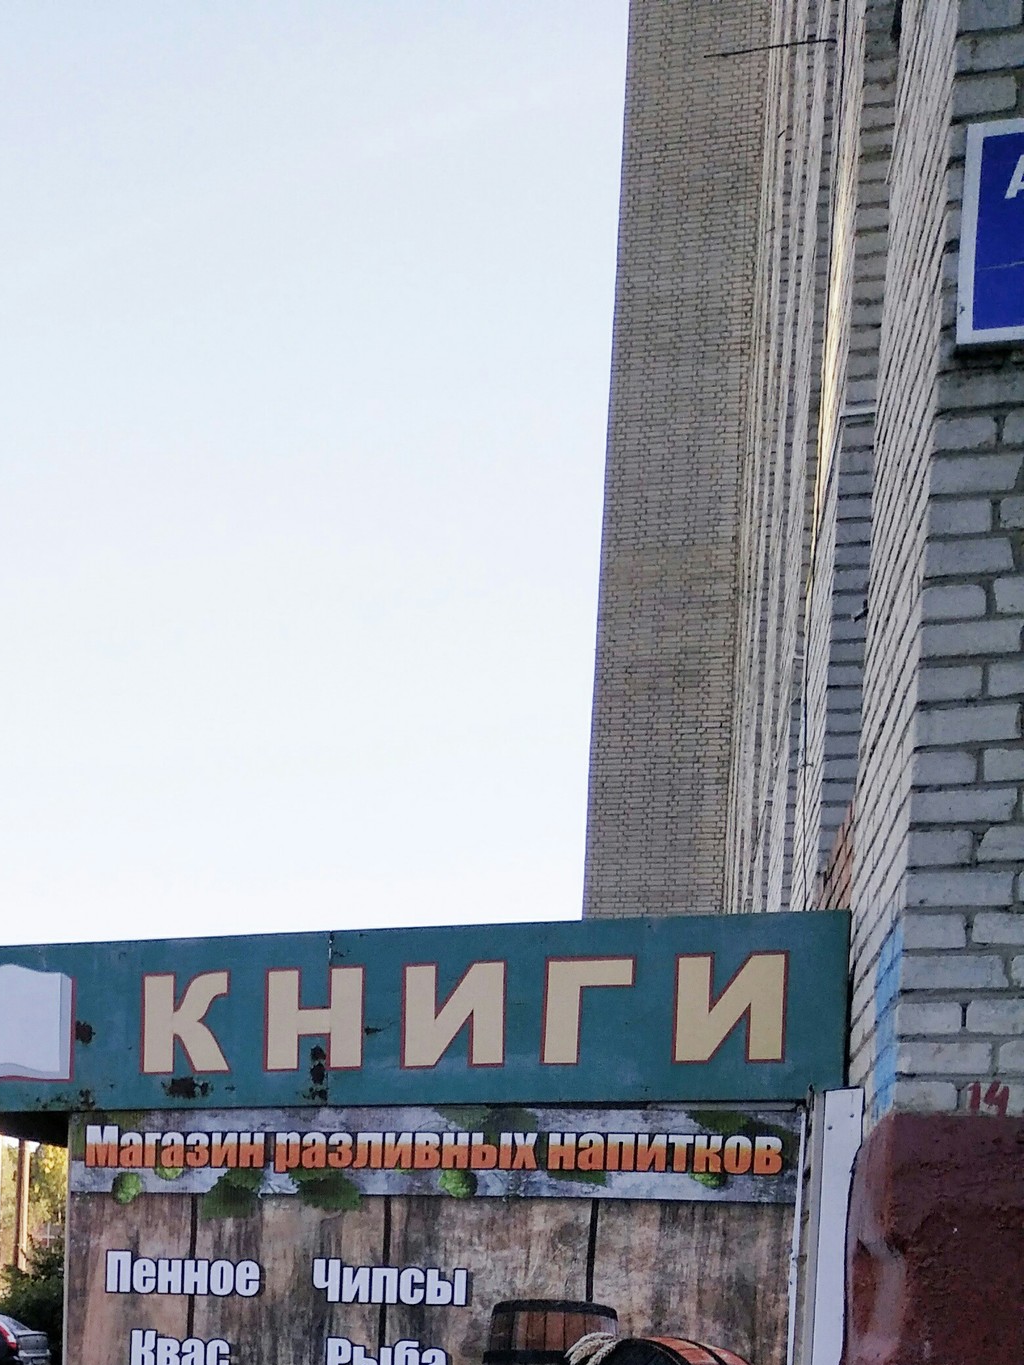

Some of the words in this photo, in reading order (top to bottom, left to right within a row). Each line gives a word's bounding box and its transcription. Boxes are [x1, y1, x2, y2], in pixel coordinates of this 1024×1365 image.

[140, 950, 788, 1074] КНИГИ
[968, 1079, 1010, 1118] 14
[85, 1124, 266, 1168] Магазин
[273, 1131, 539, 1174] разливных
[547, 1132, 784, 1175] напитков
[105, 1249, 262, 1297] Пенное
[312, 1257, 469, 1306] Чипсы
